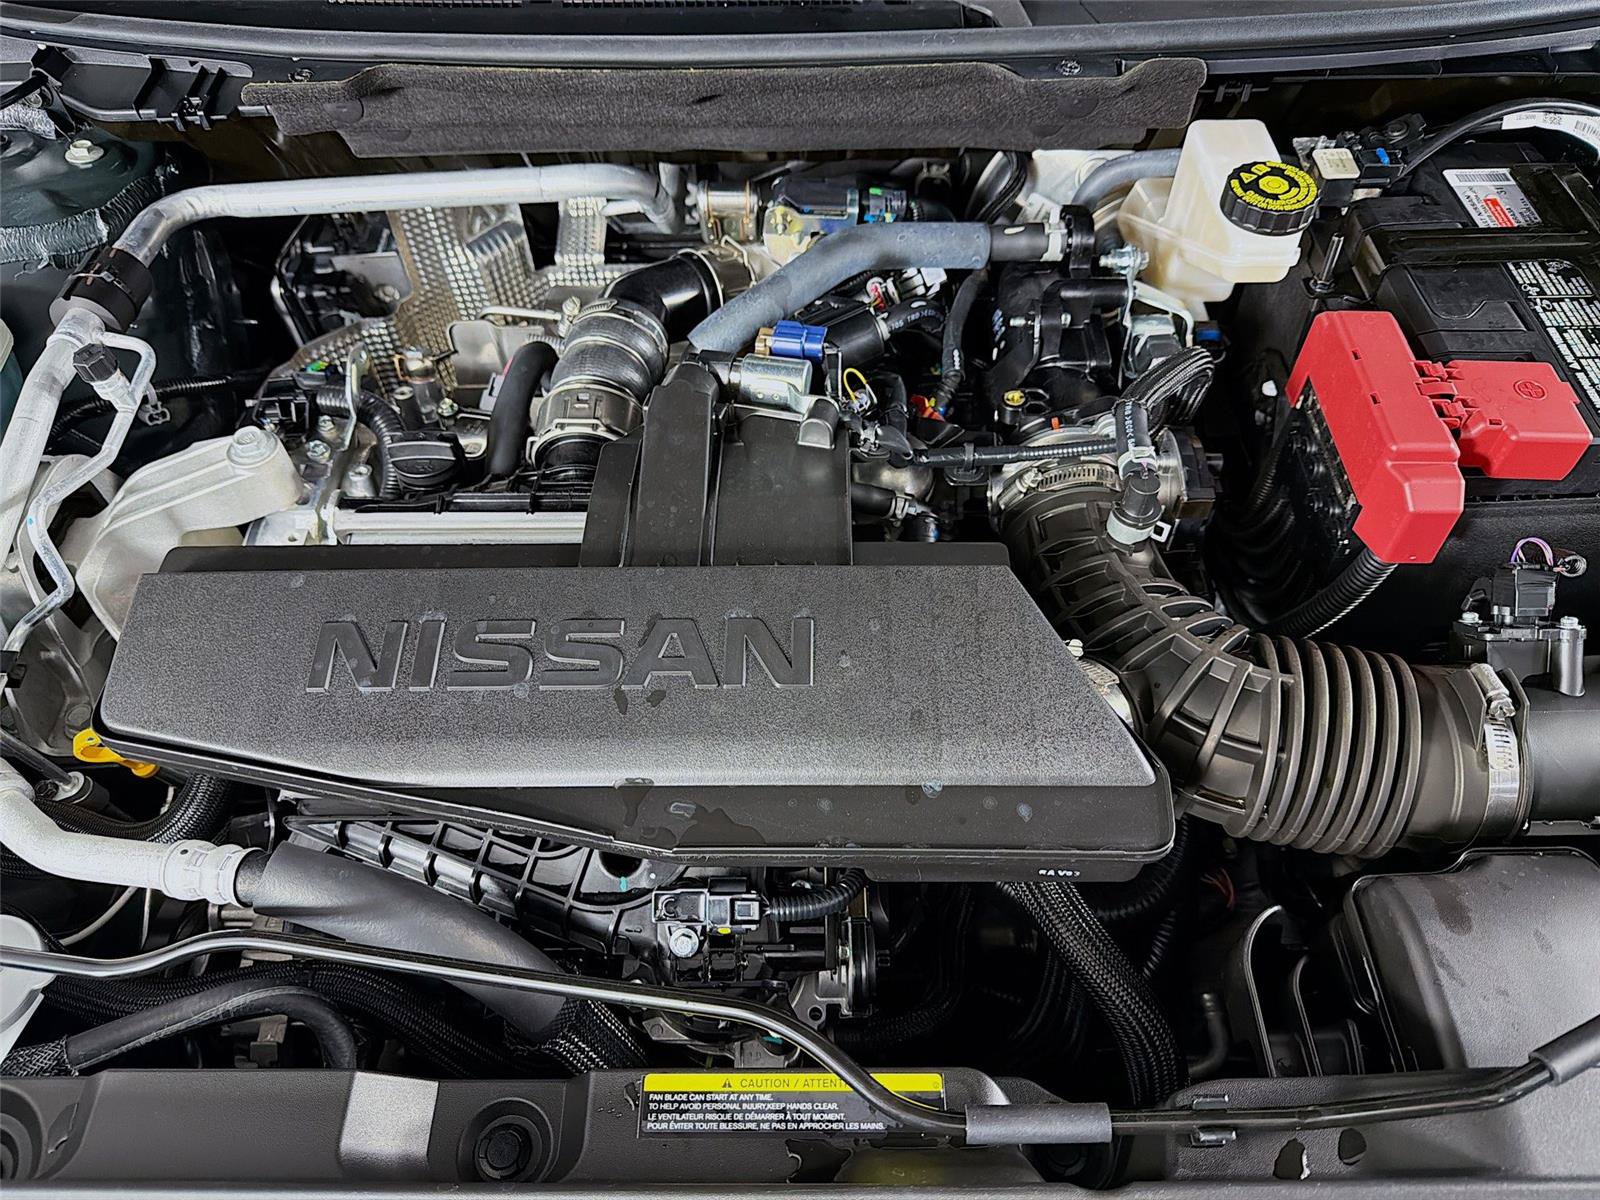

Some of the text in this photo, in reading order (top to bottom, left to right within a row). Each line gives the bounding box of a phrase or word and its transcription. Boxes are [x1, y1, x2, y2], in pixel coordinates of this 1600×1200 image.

[306, 616, 815, 692] NISSAN
[740, 1078, 790, 1088] CAUTION
[649, 1093, 663, 1101] FAN
[664, 1093, 687, 1101] BLADE
[689, 1093, 704, 1101] CAN
[706, 1093, 728, 1101] START
[729, 1093, 738, 1101] AT
[739, 1093, 755, 1101] ANY
[745, 1111, 785, 1120] DÉMARRER
[646, 1120, 883, 1130] POUR ÉVITER TOUTE BLESSURE, NE PAS EN APPROCHER LES MAINS.
